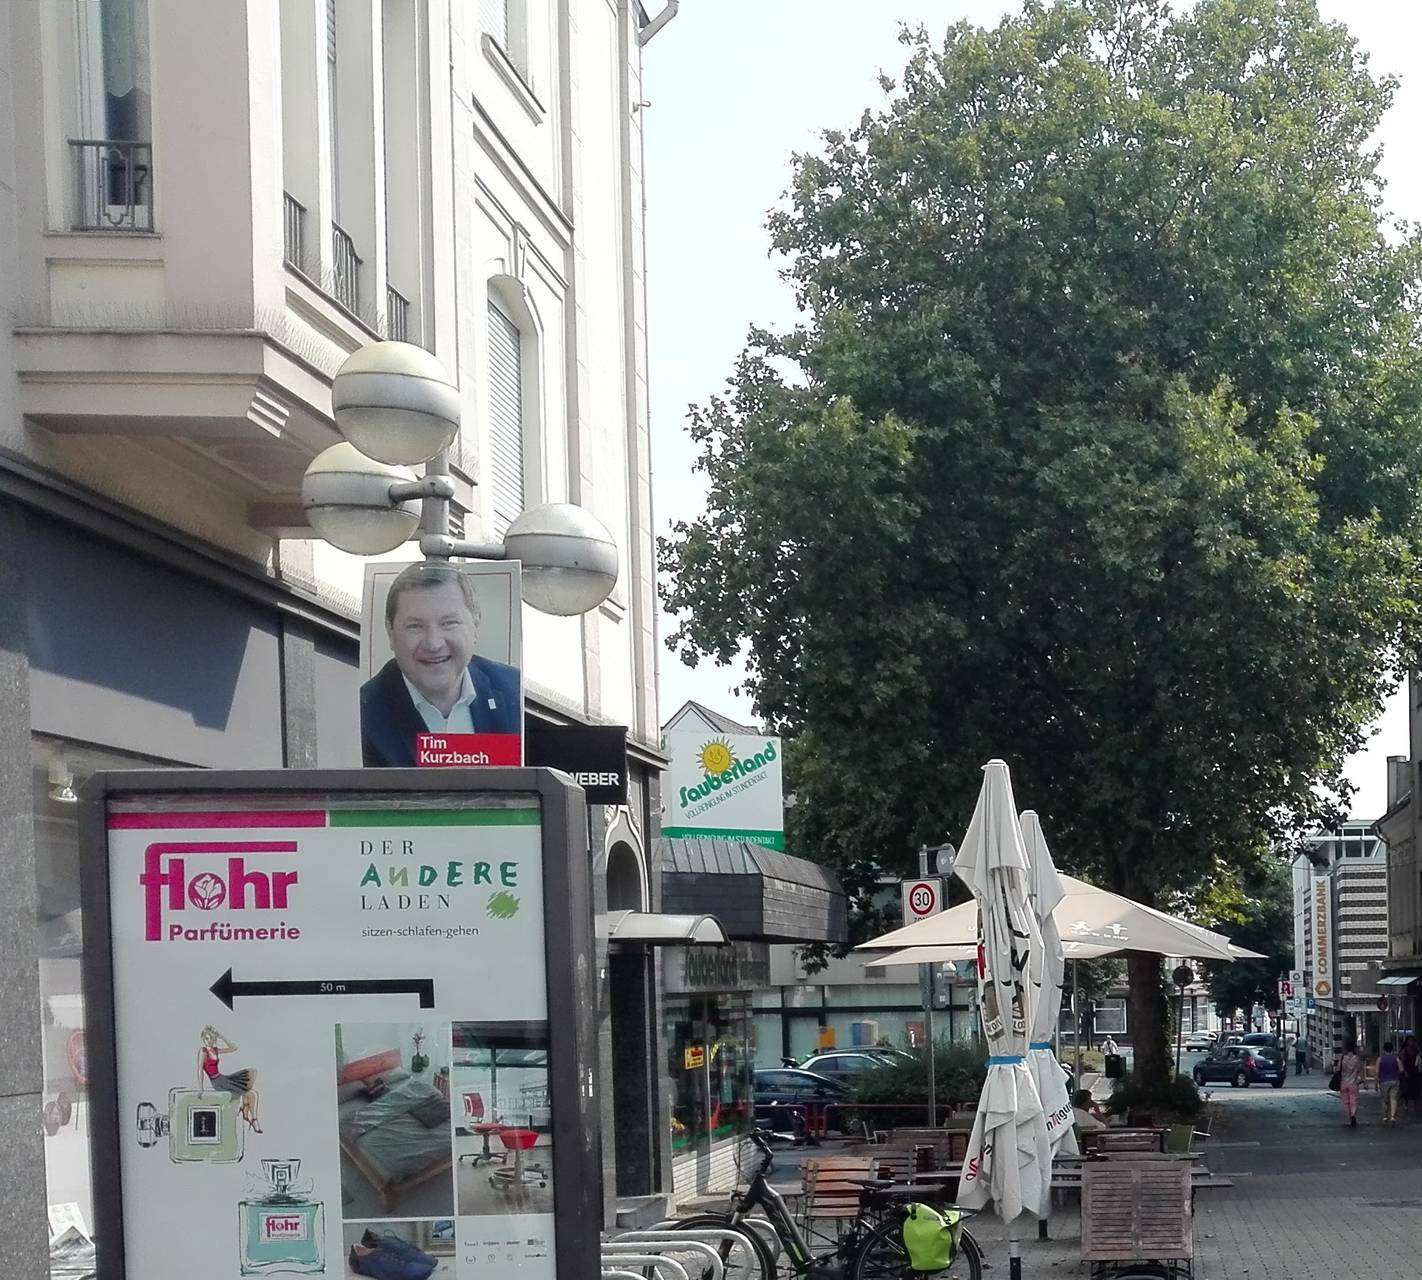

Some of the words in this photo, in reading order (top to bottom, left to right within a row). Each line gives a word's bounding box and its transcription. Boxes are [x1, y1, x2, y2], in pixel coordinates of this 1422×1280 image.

[420, 736, 447, 749] Tim
[420, 751, 489, 764] Kurzbach
[679, 741, 777, 808] Sauberland
[360, 840, 414, 855] DER
[360, 861, 519, 887] ANDERE
[140, 841, 298, 942] flohr
[361, 895, 451, 910] LADEN
[914, 892, 930, 907] 30
[169, 921, 300, 941] Parfümerie
[361, 925, 479, 939] sitzen-schlafen-gehen
[1316, 880, 1328, 975] COMMERZBANK
[320, 982, 333, 992] 50
[266, 1216, 300, 1237] flohr
